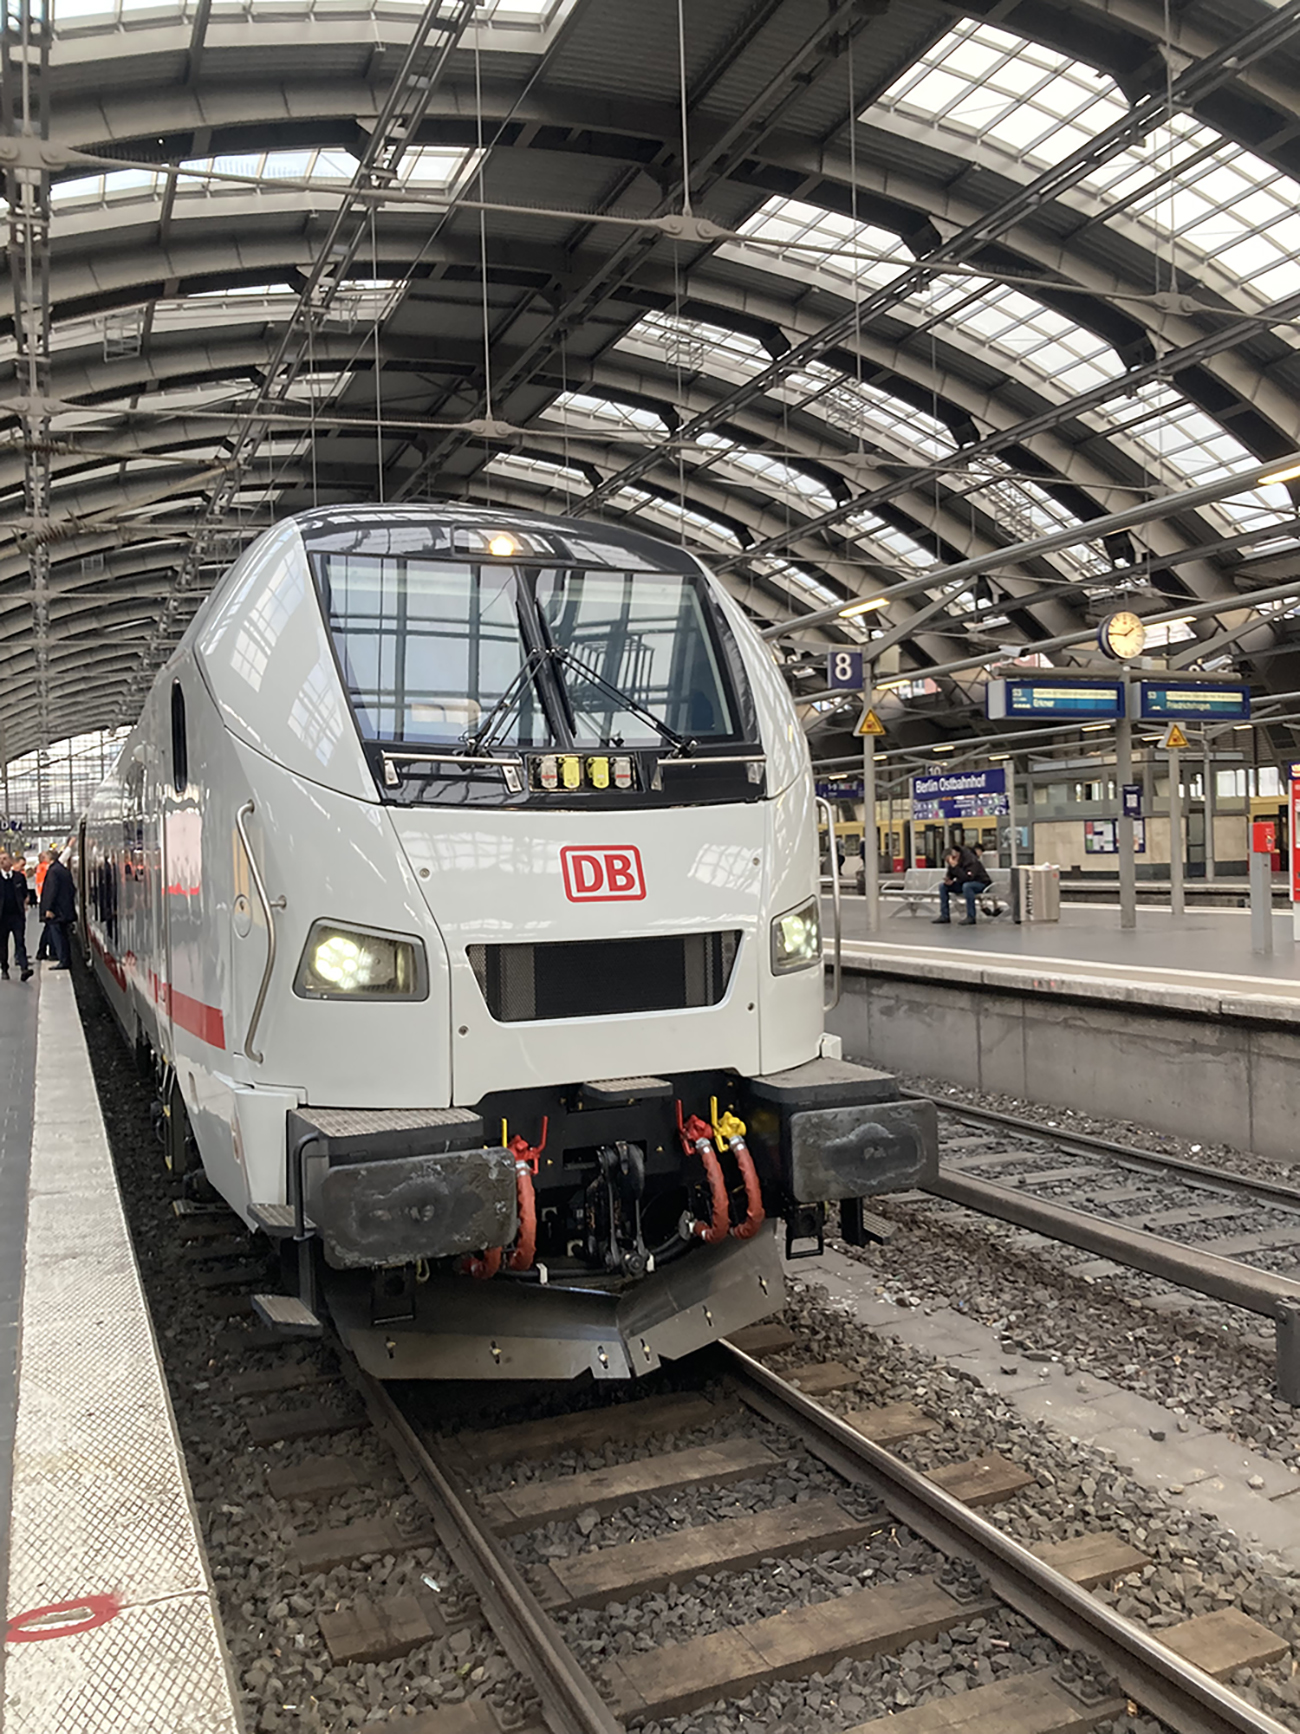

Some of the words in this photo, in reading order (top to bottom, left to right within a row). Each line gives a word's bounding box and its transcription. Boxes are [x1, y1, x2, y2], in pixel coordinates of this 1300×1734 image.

[835, 652, 852, 681] 8
[915, 780, 938, 793] Berlin
[939, 773, 986, 791] Ostbahnhof
[571, 853, 636, 893] DB
